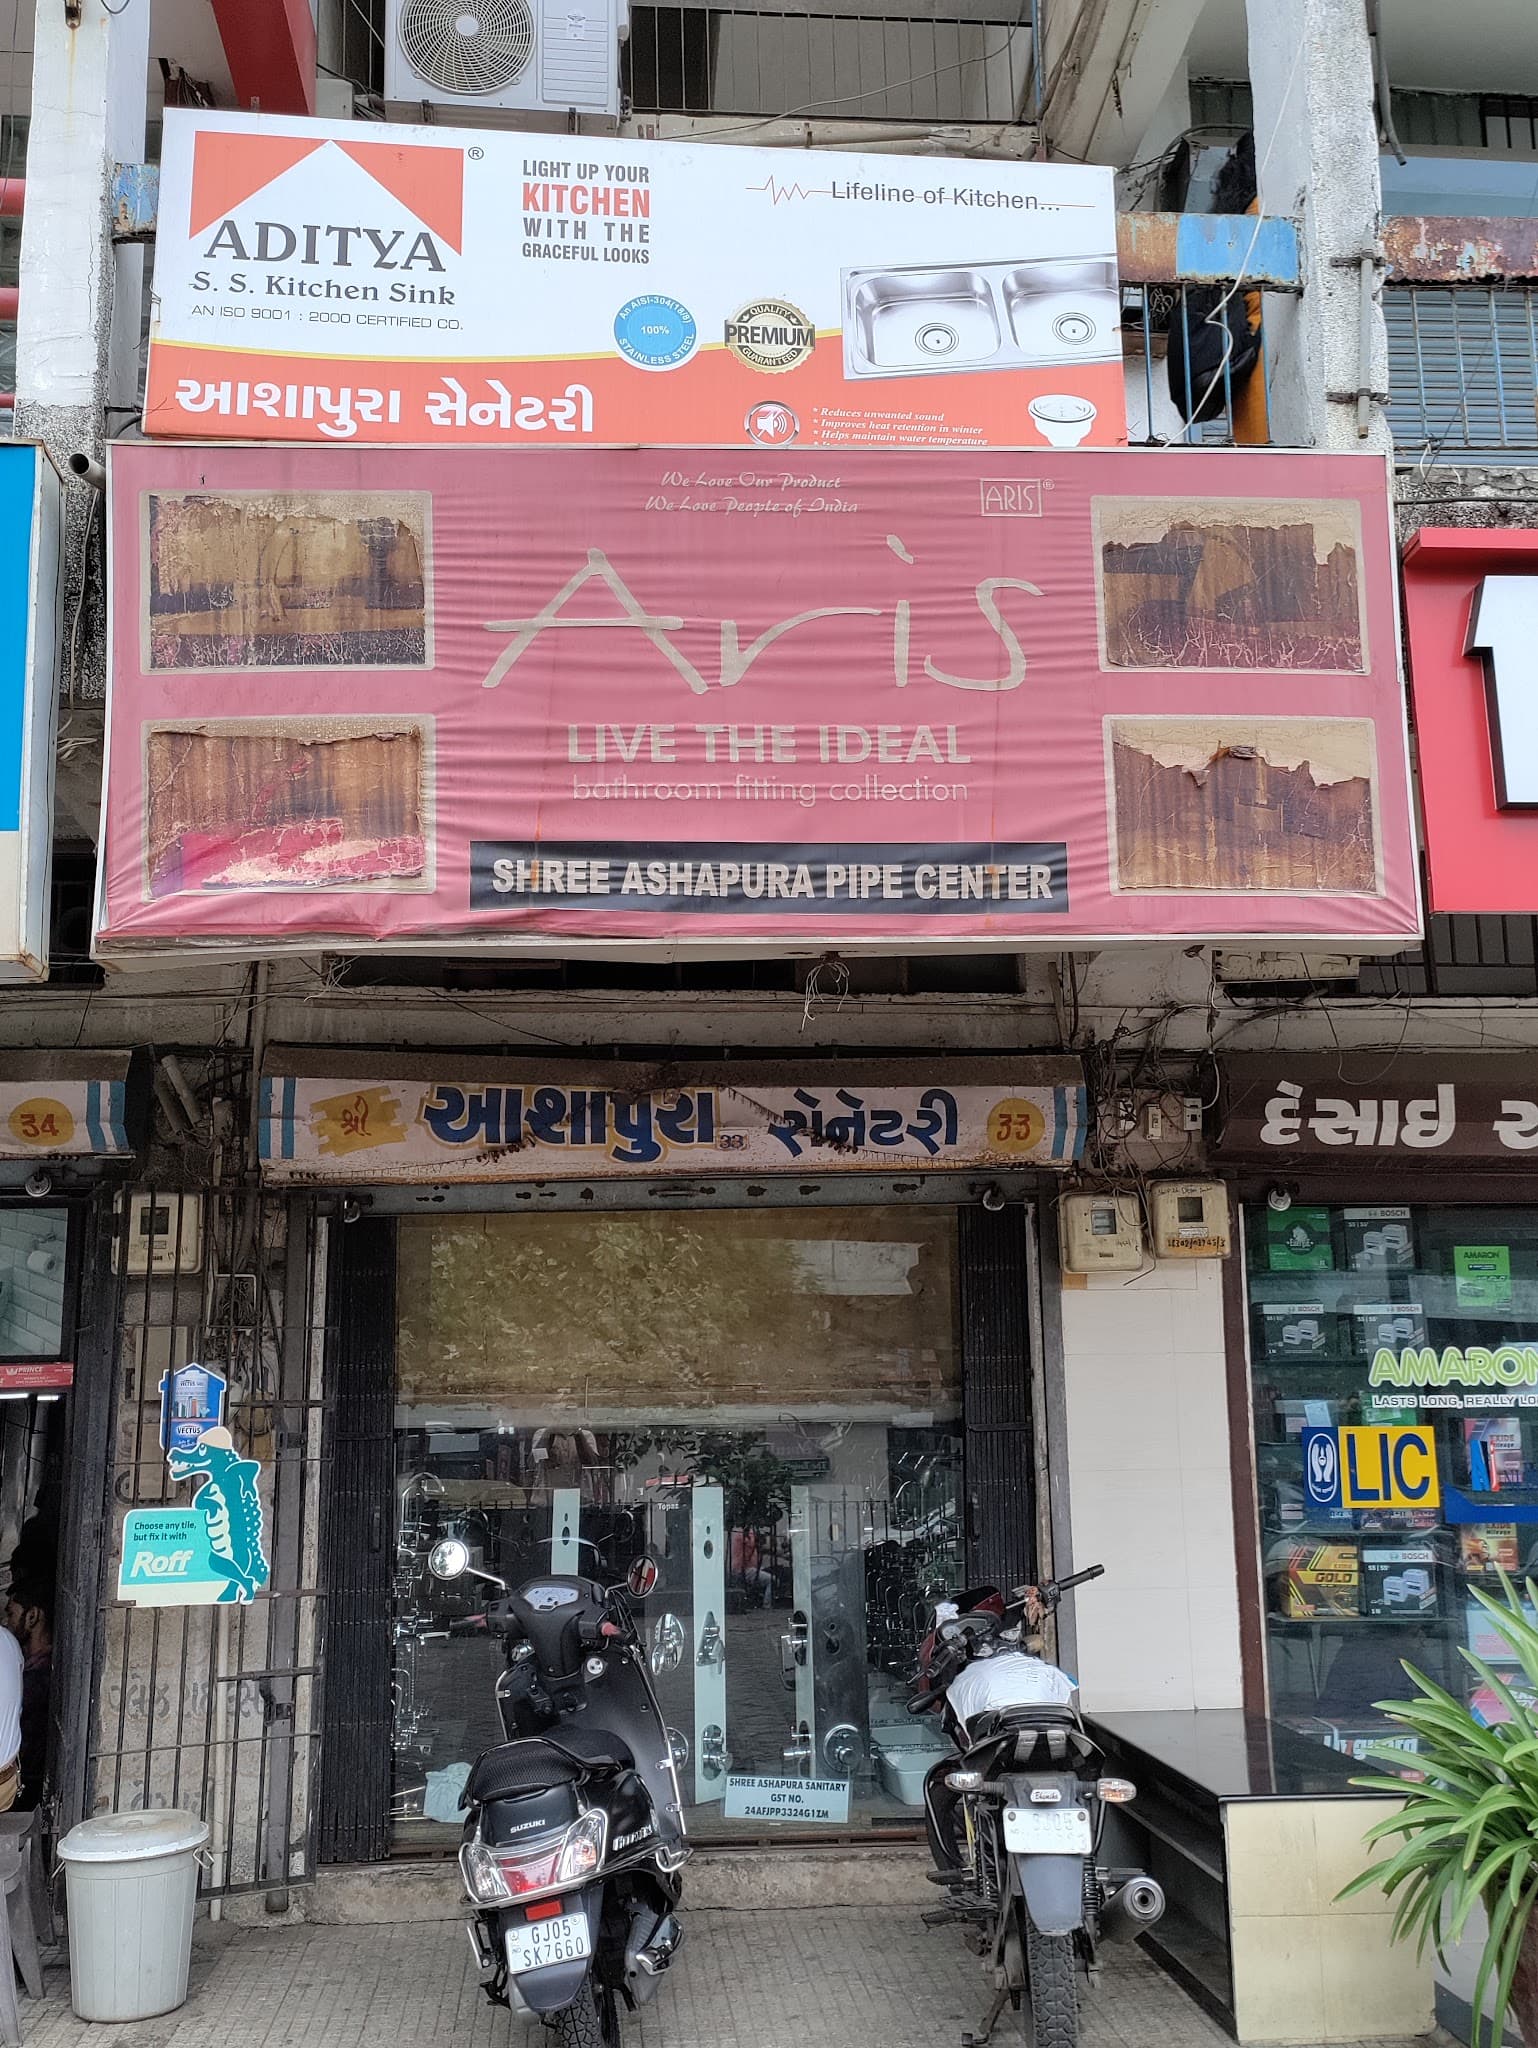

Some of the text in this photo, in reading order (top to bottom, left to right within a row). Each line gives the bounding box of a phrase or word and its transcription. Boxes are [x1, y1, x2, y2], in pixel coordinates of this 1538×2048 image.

[523, 159, 649, 183] LIGHT UP YOUR
[523, 182, 650, 218] KITCHEN
[832, 181, 914, 203] Lifeline
[923, 187, 945, 204] of
[523, 217, 650, 243] WITH THE
[204, 220, 446, 272] ADITYA
[522, 242, 650, 264] GRACEFUL LOOKS
[189, 271, 456, 305] S. S. Kitchen Sink
[191, 305, 215, 316] AN
[220, 306, 246, 318] ISO
[251, 308, 291, 320] 9001
[309, 311, 351, 324] 2000
[356, 314, 432, 328] CERTIFIED
[437, 318, 464, 330] CO.
[750, 306, 791, 317] QUALITY
[640, 325, 670, 335] 100%
[726, 325, 815, 348] PREMIUM
[619, 334, 694, 365] STAINLESS STEEL
[741, 347, 799, 367] GUARANTEED
[175, 376, 594, 437] આશાપુરા સેનેટરી
[821, 408, 944, 422] Reduces unwanted sound
[821, 419, 983, 435] Improves heat retention in winter
[821, 430, 850, 440] Helps
[852, 432, 896, 441] maintain
[899, 436, 926, 444] water
[928, 436, 988, 446] temperature
[661, 471, 841, 492] We Love Our Product
[644, 496, 858, 518] We Love People of India
[985, 484, 1036, 511] ARIS
[482, 534, 1044, 694] Aris
[567, 724, 972, 764] LIVE THE IDEAL
[573, 774, 968, 807] bathroom fitting collection
[492, 858, 1053, 901] SHREE ASHAPURA PIPE CENTER
[20, 1113, 59, 1138] 34
[421, 1084, 716, 1163] આશાપુરા
[996, 1113, 1031, 1142] 33
[1374, 1395, 1416, 1407] LASTS
[1466, 1395, 1515, 1407] REALLY
[1519, 1395, 1538, 1407] LO
[177, 1426, 201, 1434] VECTUS
[1346, 1433, 1431, 1502] LIC
[133, 1532, 148, 1541] but
[149, 1532, 160, 1541] fix
[168, 1531, 187, 1541] with
[135, 1521, 197, 1532] Choose any tile,
[129, 1550, 195, 1578] Roff
[1401, 1552, 1429, 1561] BOSCH
[1315, 1572, 1353, 1584] GOLD
[729, 1778, 846, 1792] SHREE ASHAPURA SANITARY
[771, 1793, 804, 1804] GST NO.
[510, 1819, 546, 1834] SUZUKI
[531, 1919, 571, 1945] GJ05
[523, 1936, 584, 1967] SK7660
